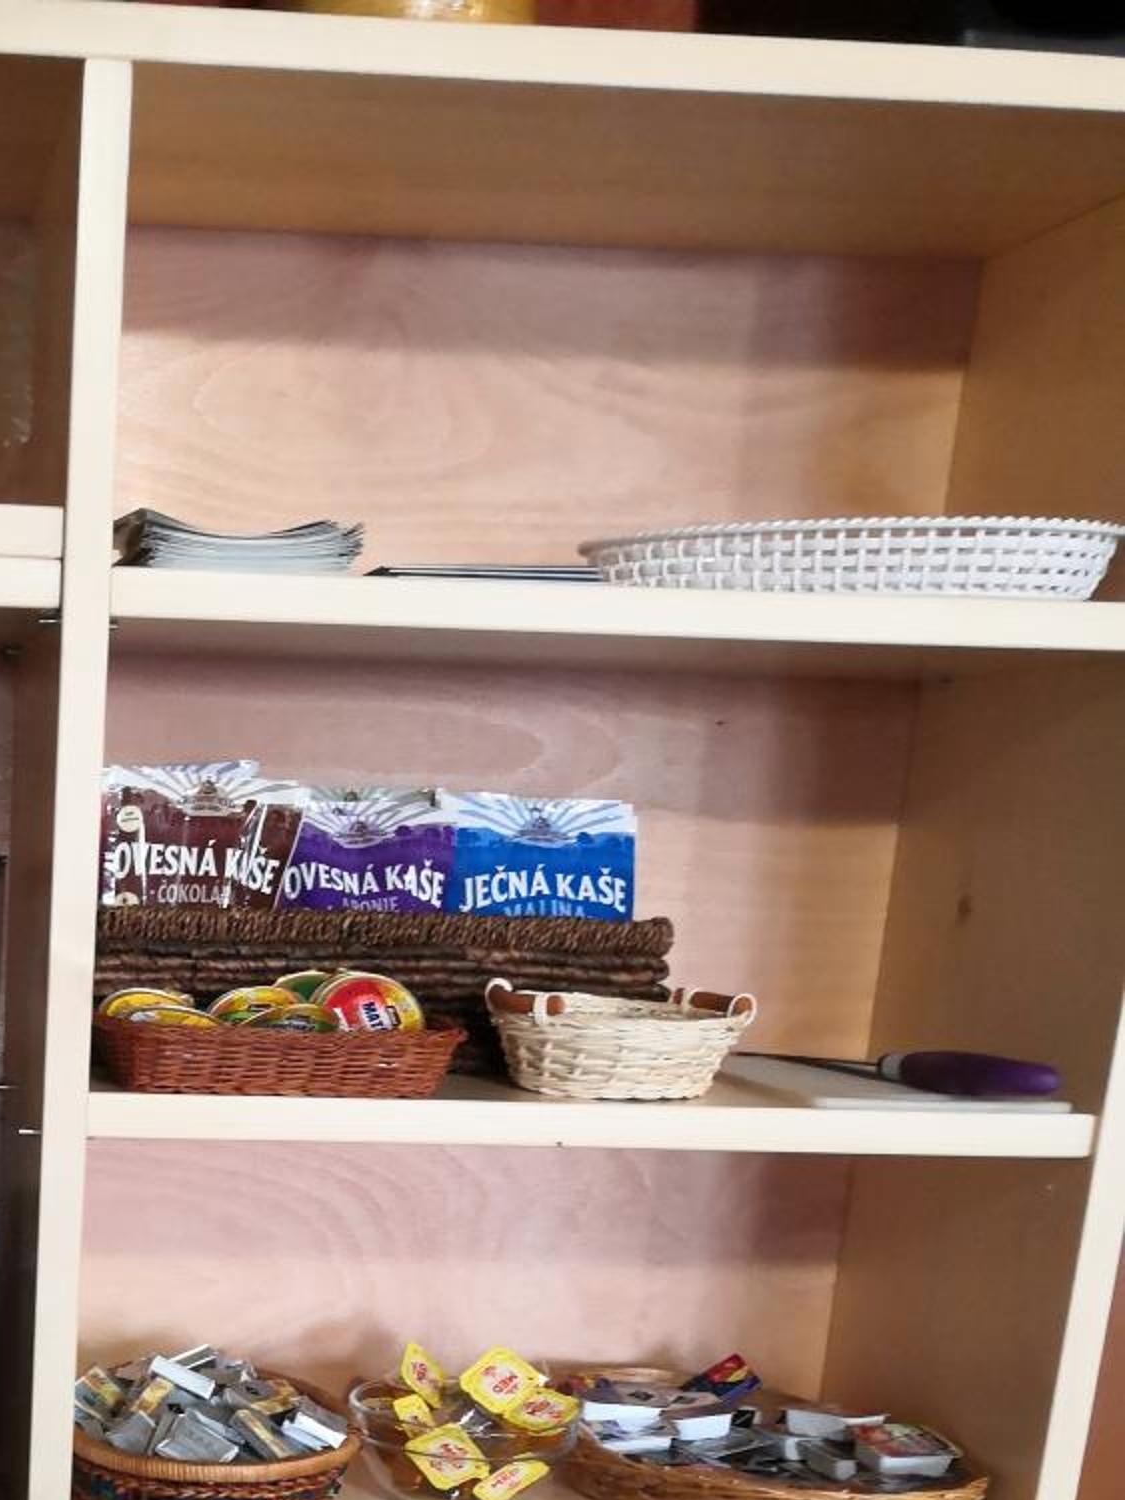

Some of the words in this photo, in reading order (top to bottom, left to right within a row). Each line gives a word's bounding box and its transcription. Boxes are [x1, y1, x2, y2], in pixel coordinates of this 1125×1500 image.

[114, 839, 218, 879] OVESNÁ
[284, 861, 379, 900] OVESNÁ
[385, 859, 446, 909] KAŠE
[459, 863, 552, 913] JEČNÁ
[555, 865, 627, 914] KAŠE
